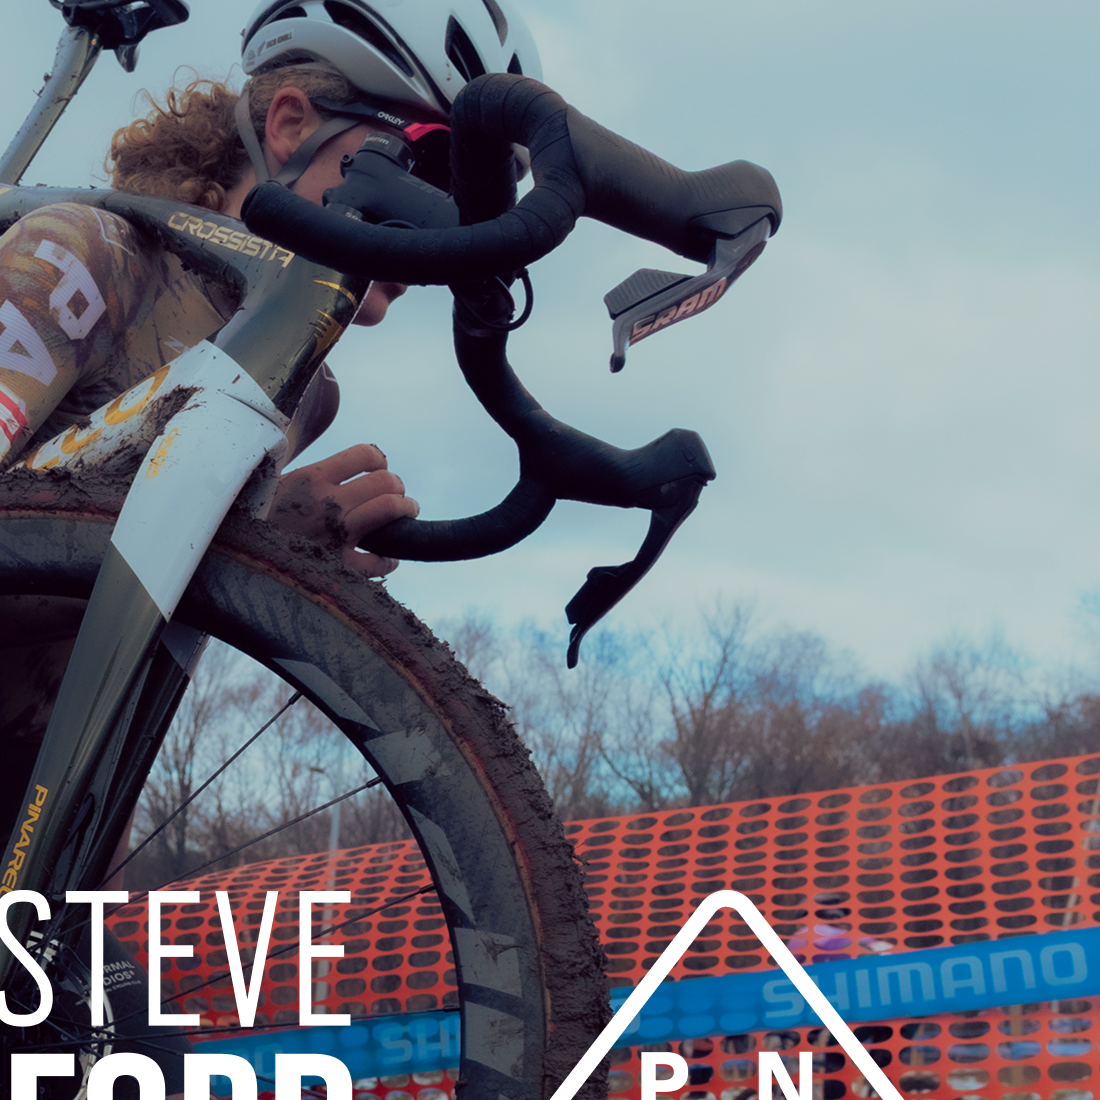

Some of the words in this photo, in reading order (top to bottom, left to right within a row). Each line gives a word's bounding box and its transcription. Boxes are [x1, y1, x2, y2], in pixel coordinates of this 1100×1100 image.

[376, 111, 405, 126] OAKLEY
[167, 211, 295, 268] CROSSISTA
[632, 277, 727, 339] SRAM
[762, 942, 1088, 1019] SHIMANO
